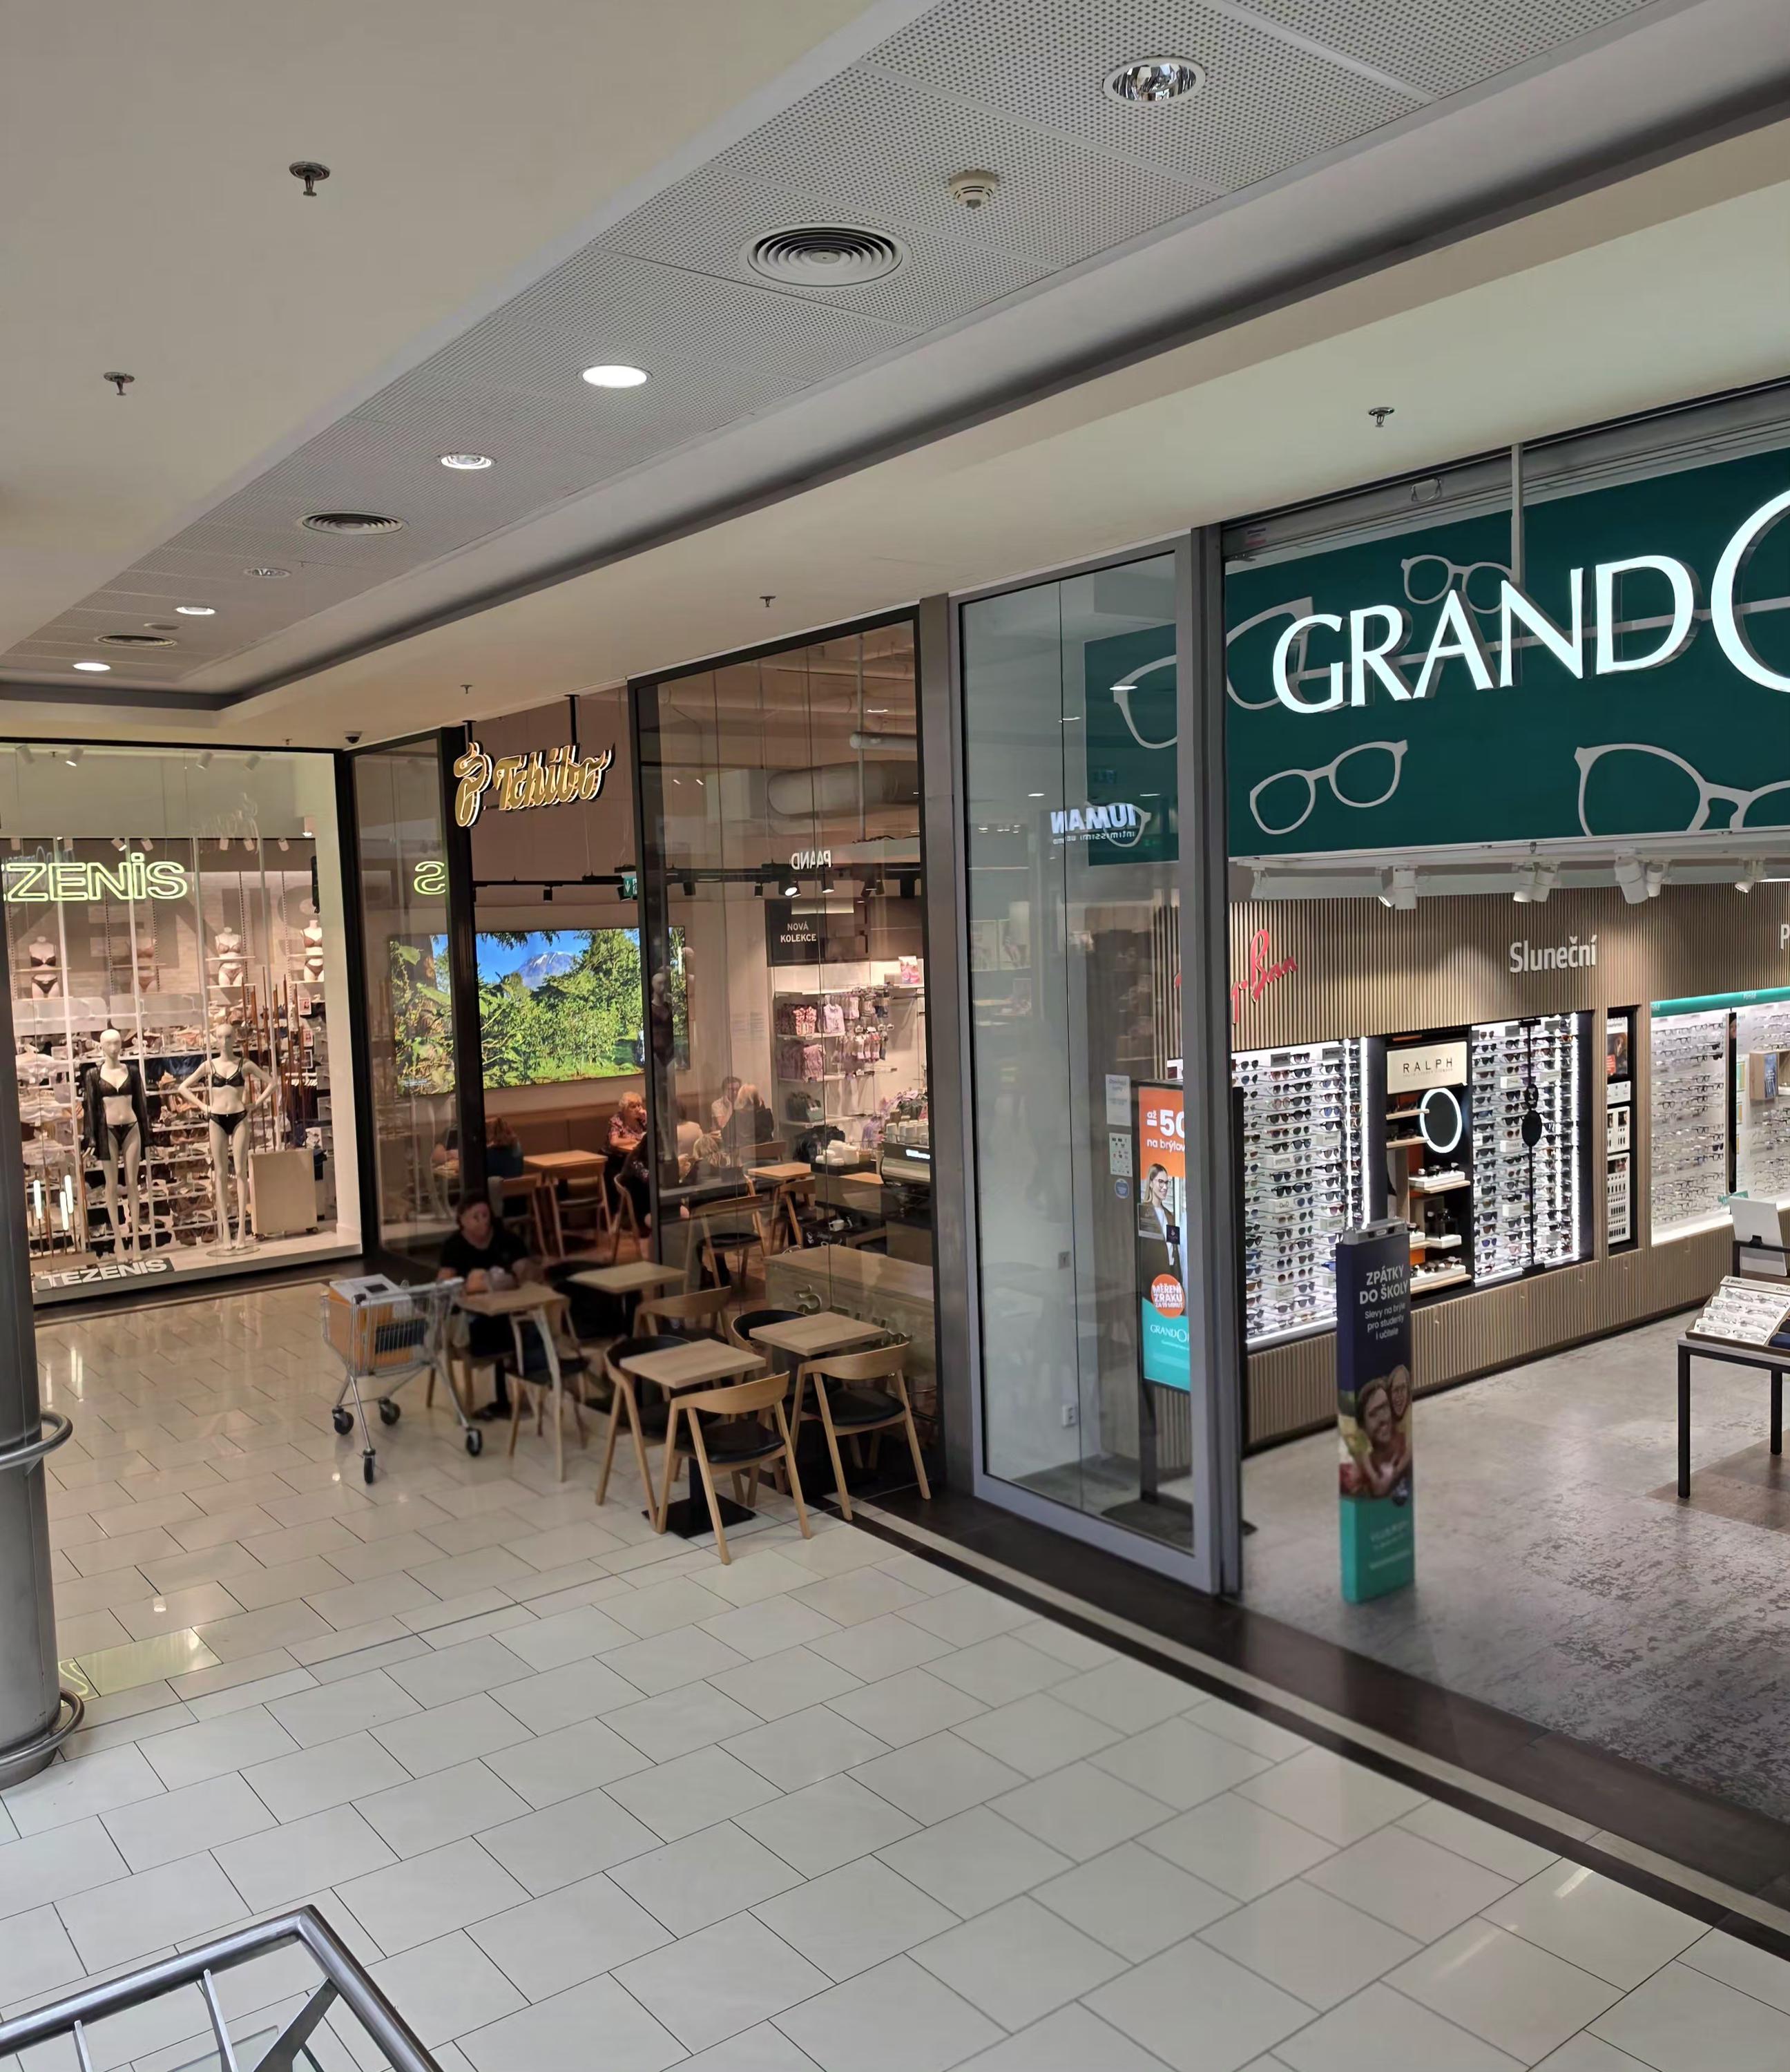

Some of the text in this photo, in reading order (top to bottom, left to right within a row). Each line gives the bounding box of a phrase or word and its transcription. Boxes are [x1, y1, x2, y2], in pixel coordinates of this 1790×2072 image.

[492, 745, 616, 812] Tchibo
[787, 921, 809, 931] NOVÁ
[780, 934, 816, 943] KOLEKCE
[1510, 934, 1597, 973] Sluneční
[1403, 1057, 1453, 1074] RALPH
[1146, 1139, 1158, 1148] na
[41, 1258, 168, 1288] TEZENIS
[1366, 1264, 1405, 1286] ZPÁTKY
[1153, 1293, 1183, 1303] ZRAKU
[1359, 1280, 1409, 1305] DO ŠKOLY
[1365, 1307, 1383, 1320] Slevy
[1384, 1306, 1392, 1315] na
[1367, 1314, 1405, 1332] pro studenty
